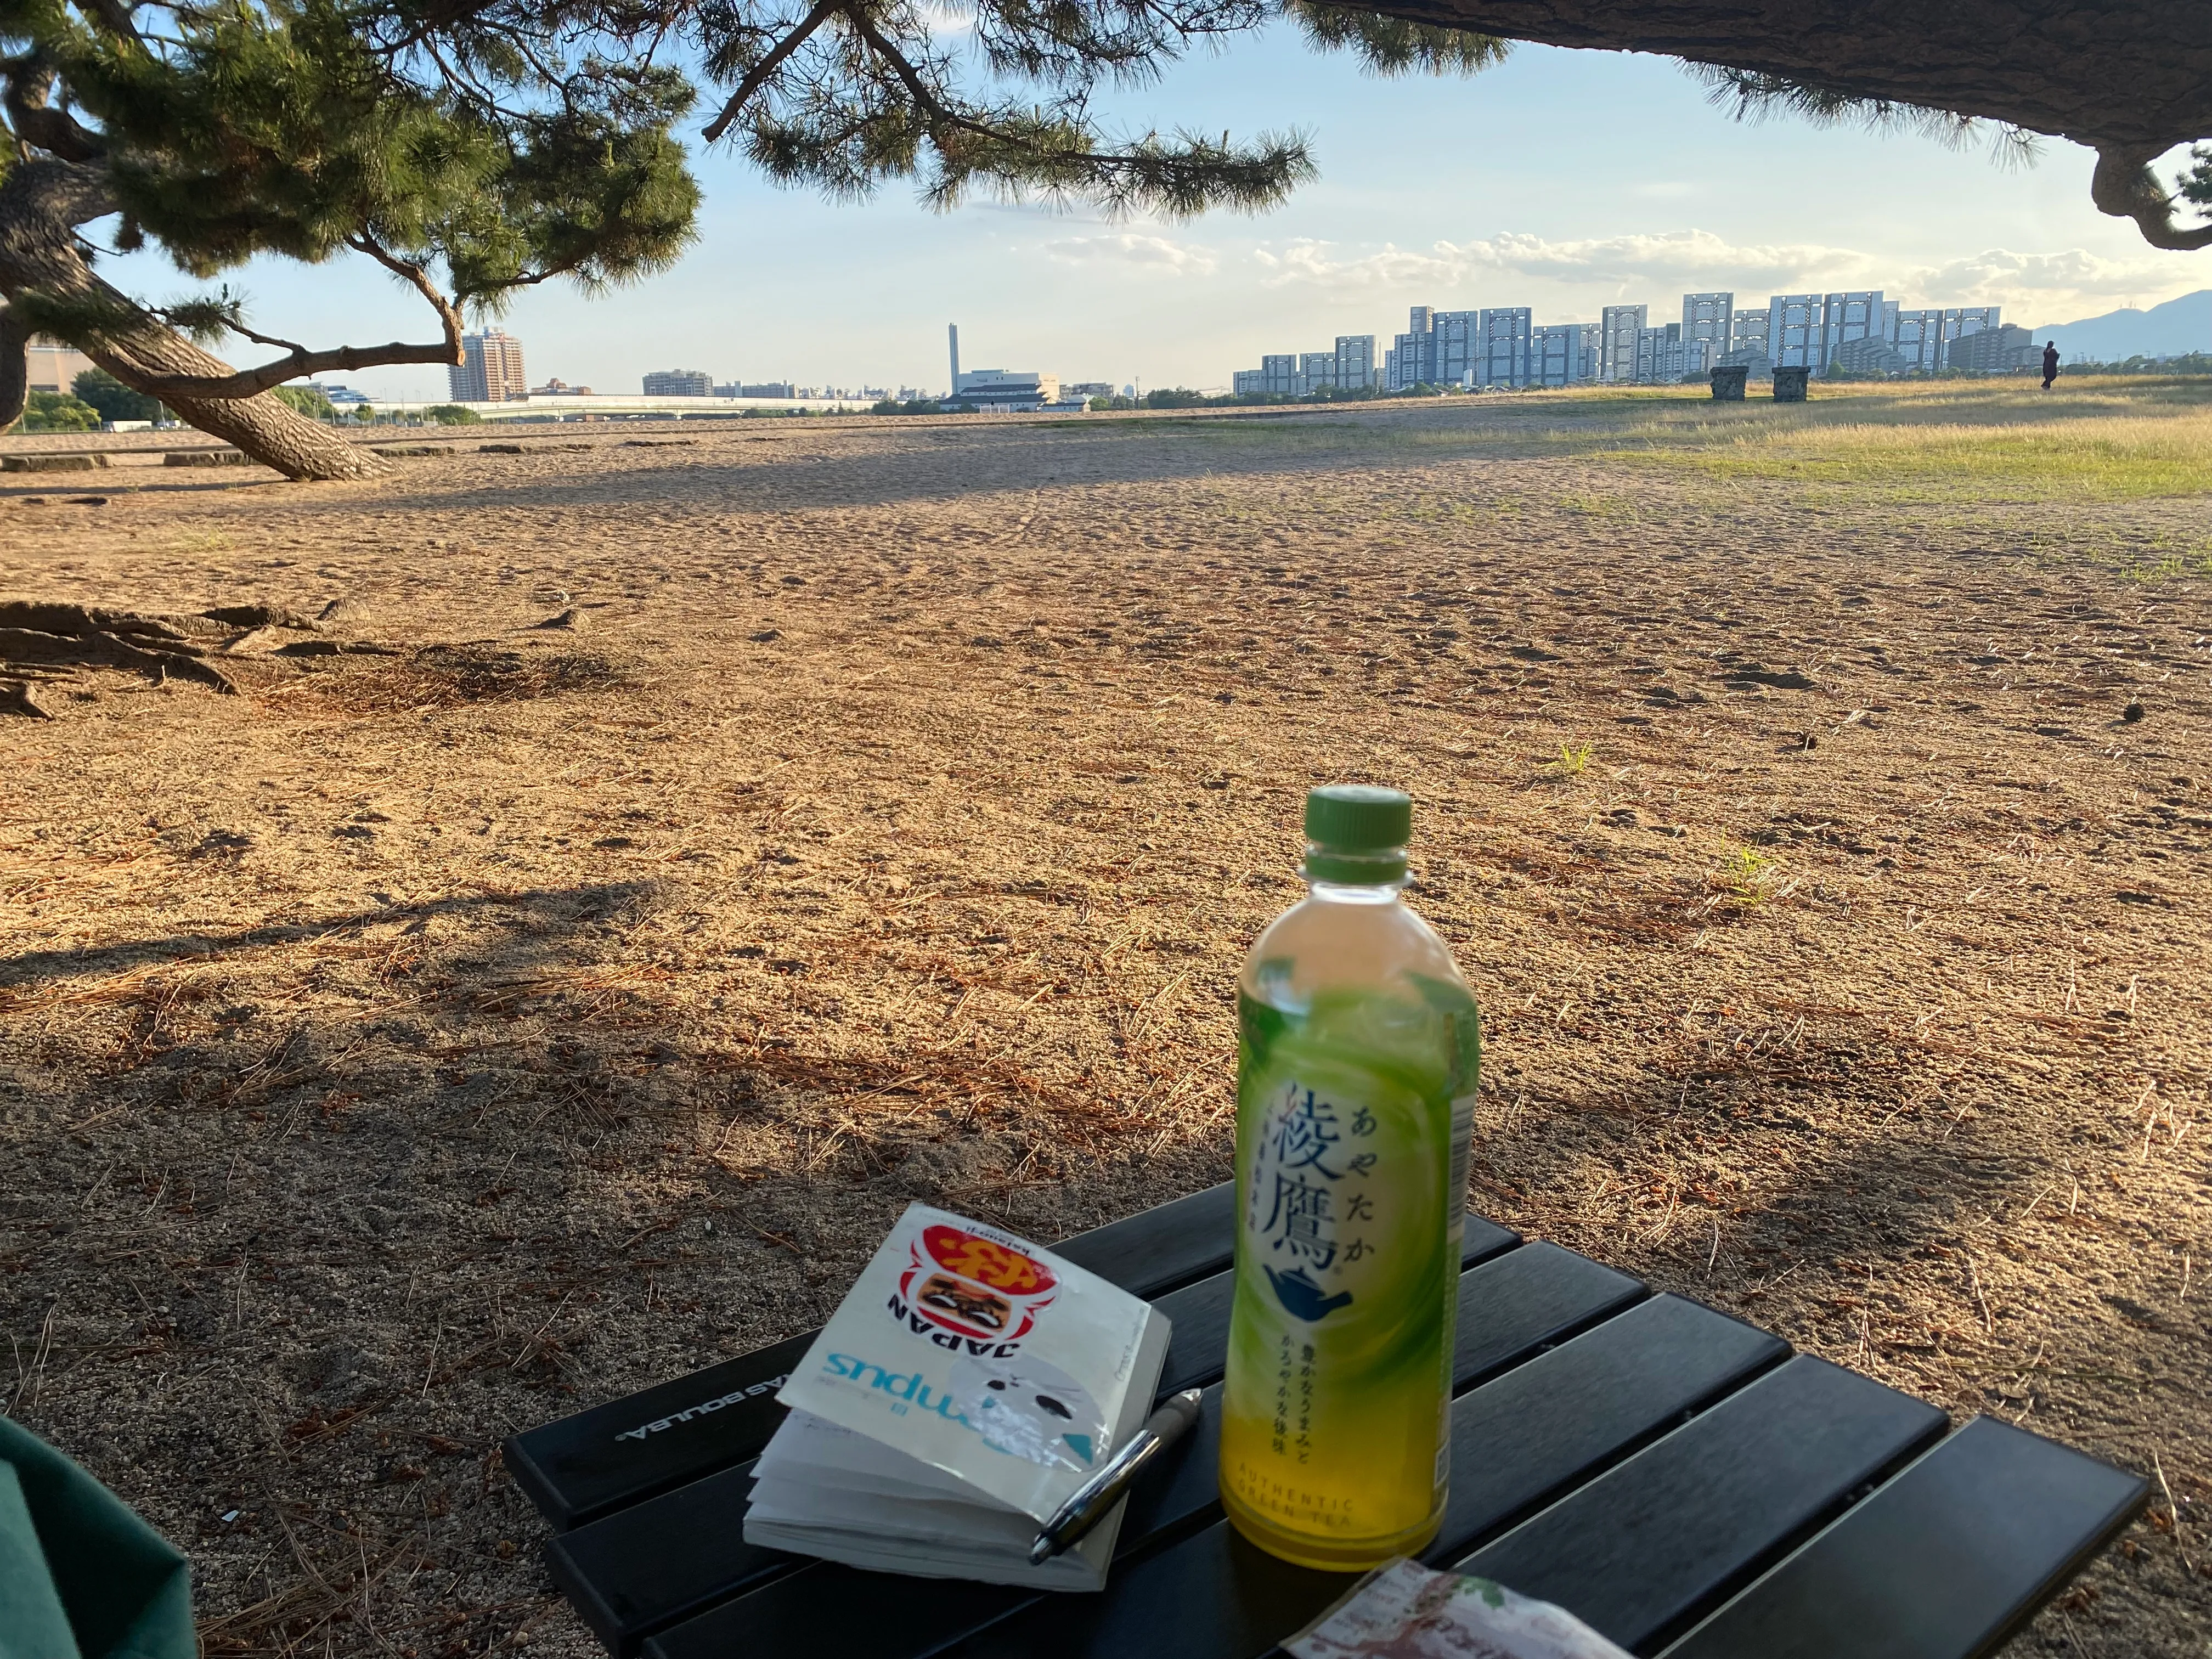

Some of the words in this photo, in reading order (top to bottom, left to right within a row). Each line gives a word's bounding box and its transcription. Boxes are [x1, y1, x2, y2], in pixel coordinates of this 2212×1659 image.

[1262, 1080, 1345, 1269] 綾鷹
[1344, 1105, 1378, 1262] あやたか
[888, 1293, 1020, 1358] JAPAN
[626, 1391, 746, 1440] BOULBA
[1239, 1478, 1295, 1516] GREEN
[1311, 1511, 1351, 1527] TEA
[1240, 1462, 1353, 1511] AUTHENTIC
